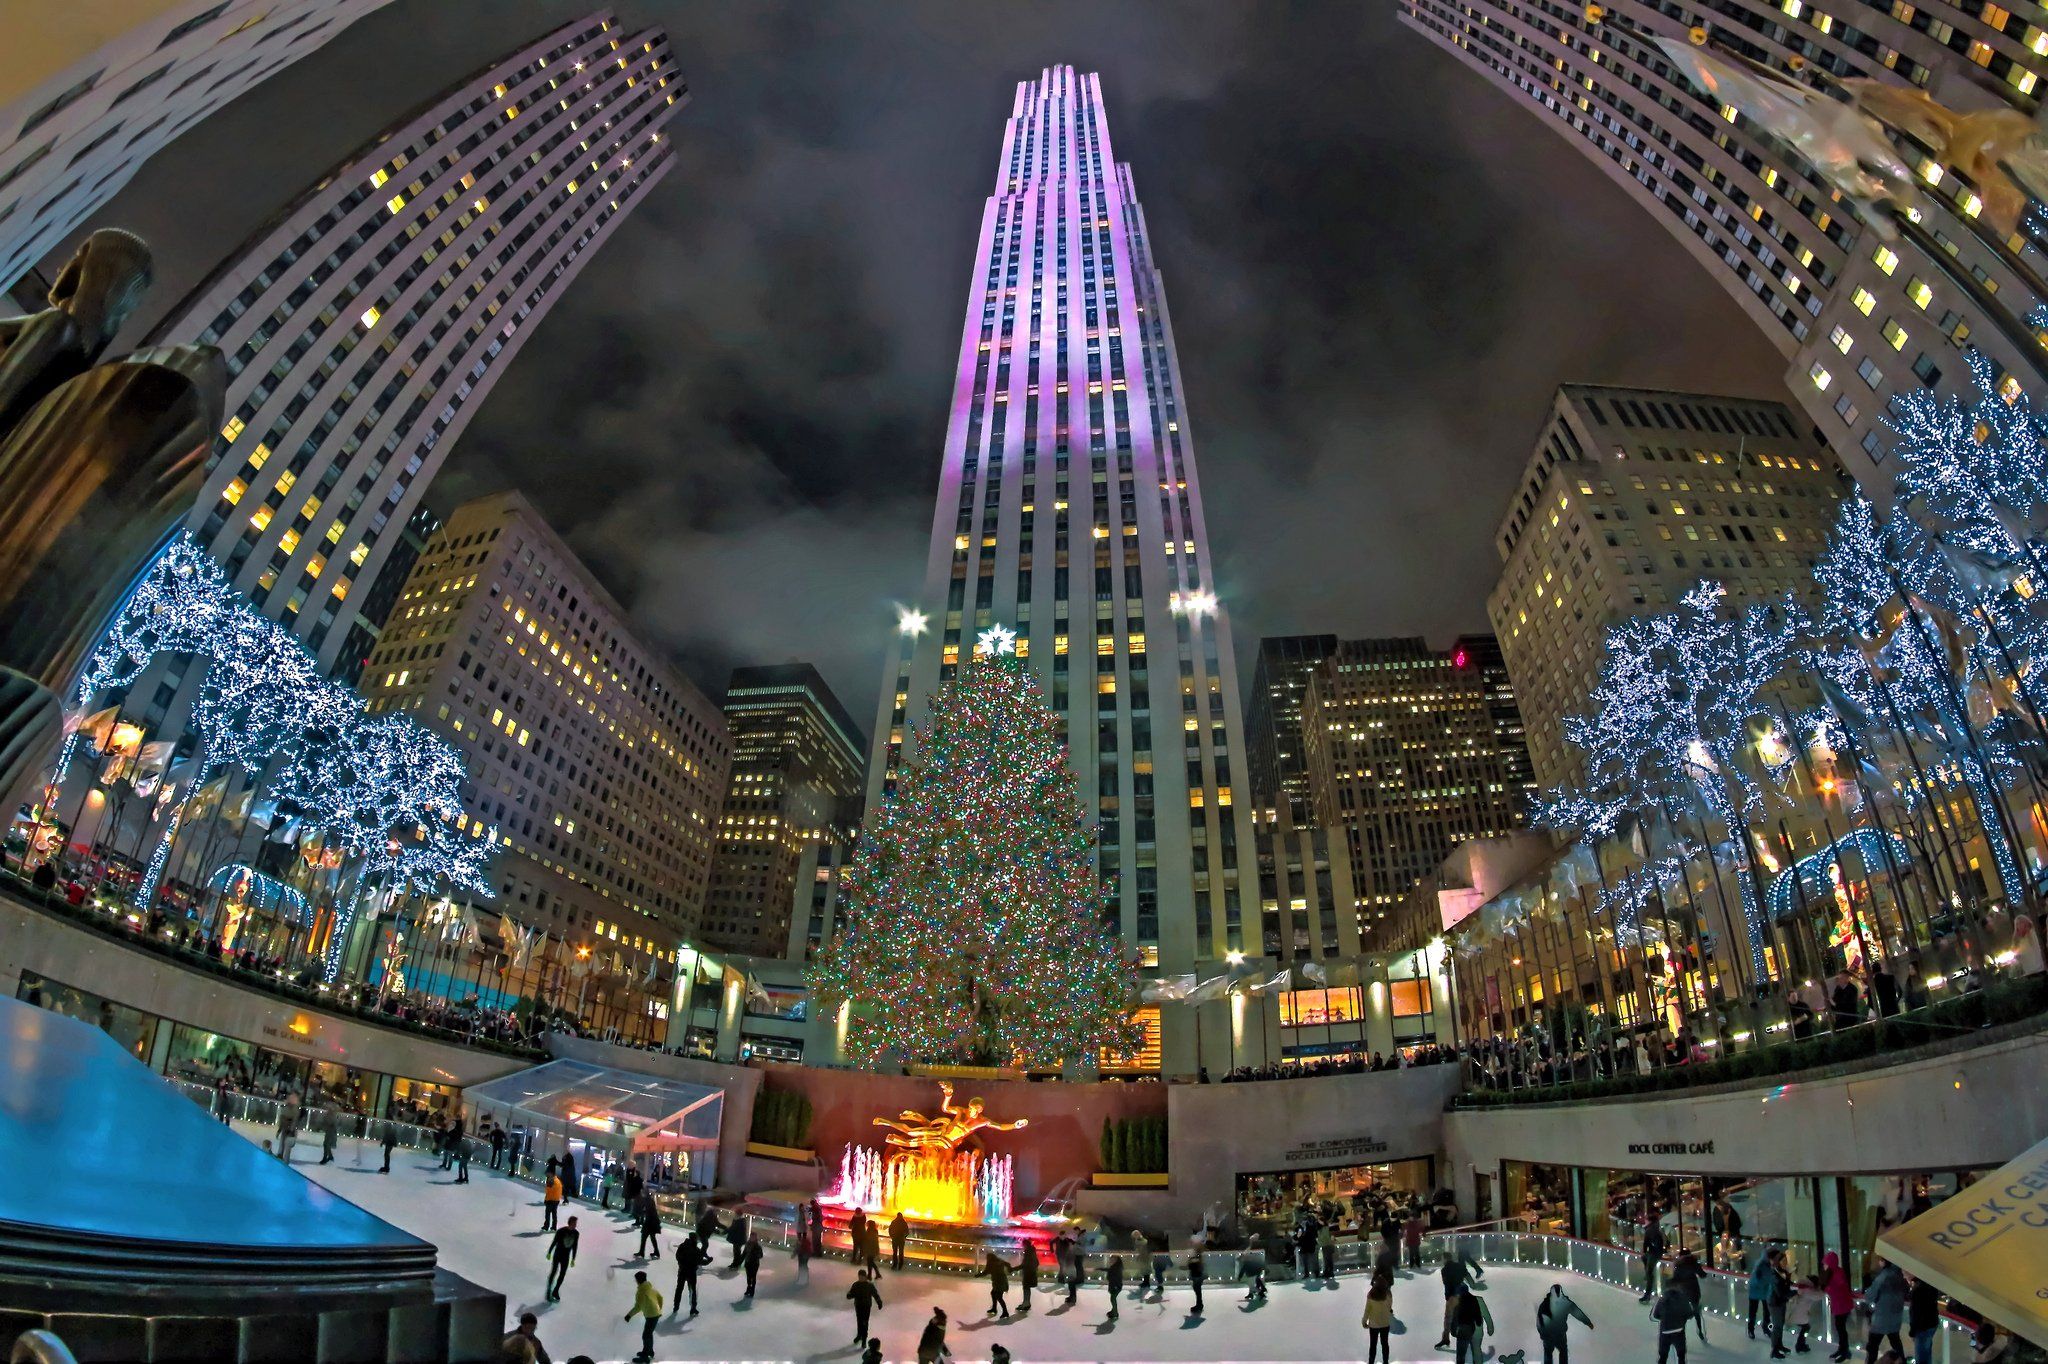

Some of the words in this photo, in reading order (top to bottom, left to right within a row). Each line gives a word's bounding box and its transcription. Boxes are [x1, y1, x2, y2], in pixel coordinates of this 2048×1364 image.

[1320, 1136, 1372, 1148] CONCOURSE
[1628, 1144, 1650, 1154] ROCK
[1652, 1144, 1687, 1154] CENTER
[1689, 1140, 1715, 1154] CAFÉ
[1285, 1149, 1348, 1161] ROCKEFELLER
[1352, 1145, 1388, 1156] CENTER
[1928, 1198, 2015, 1250] ROCK
